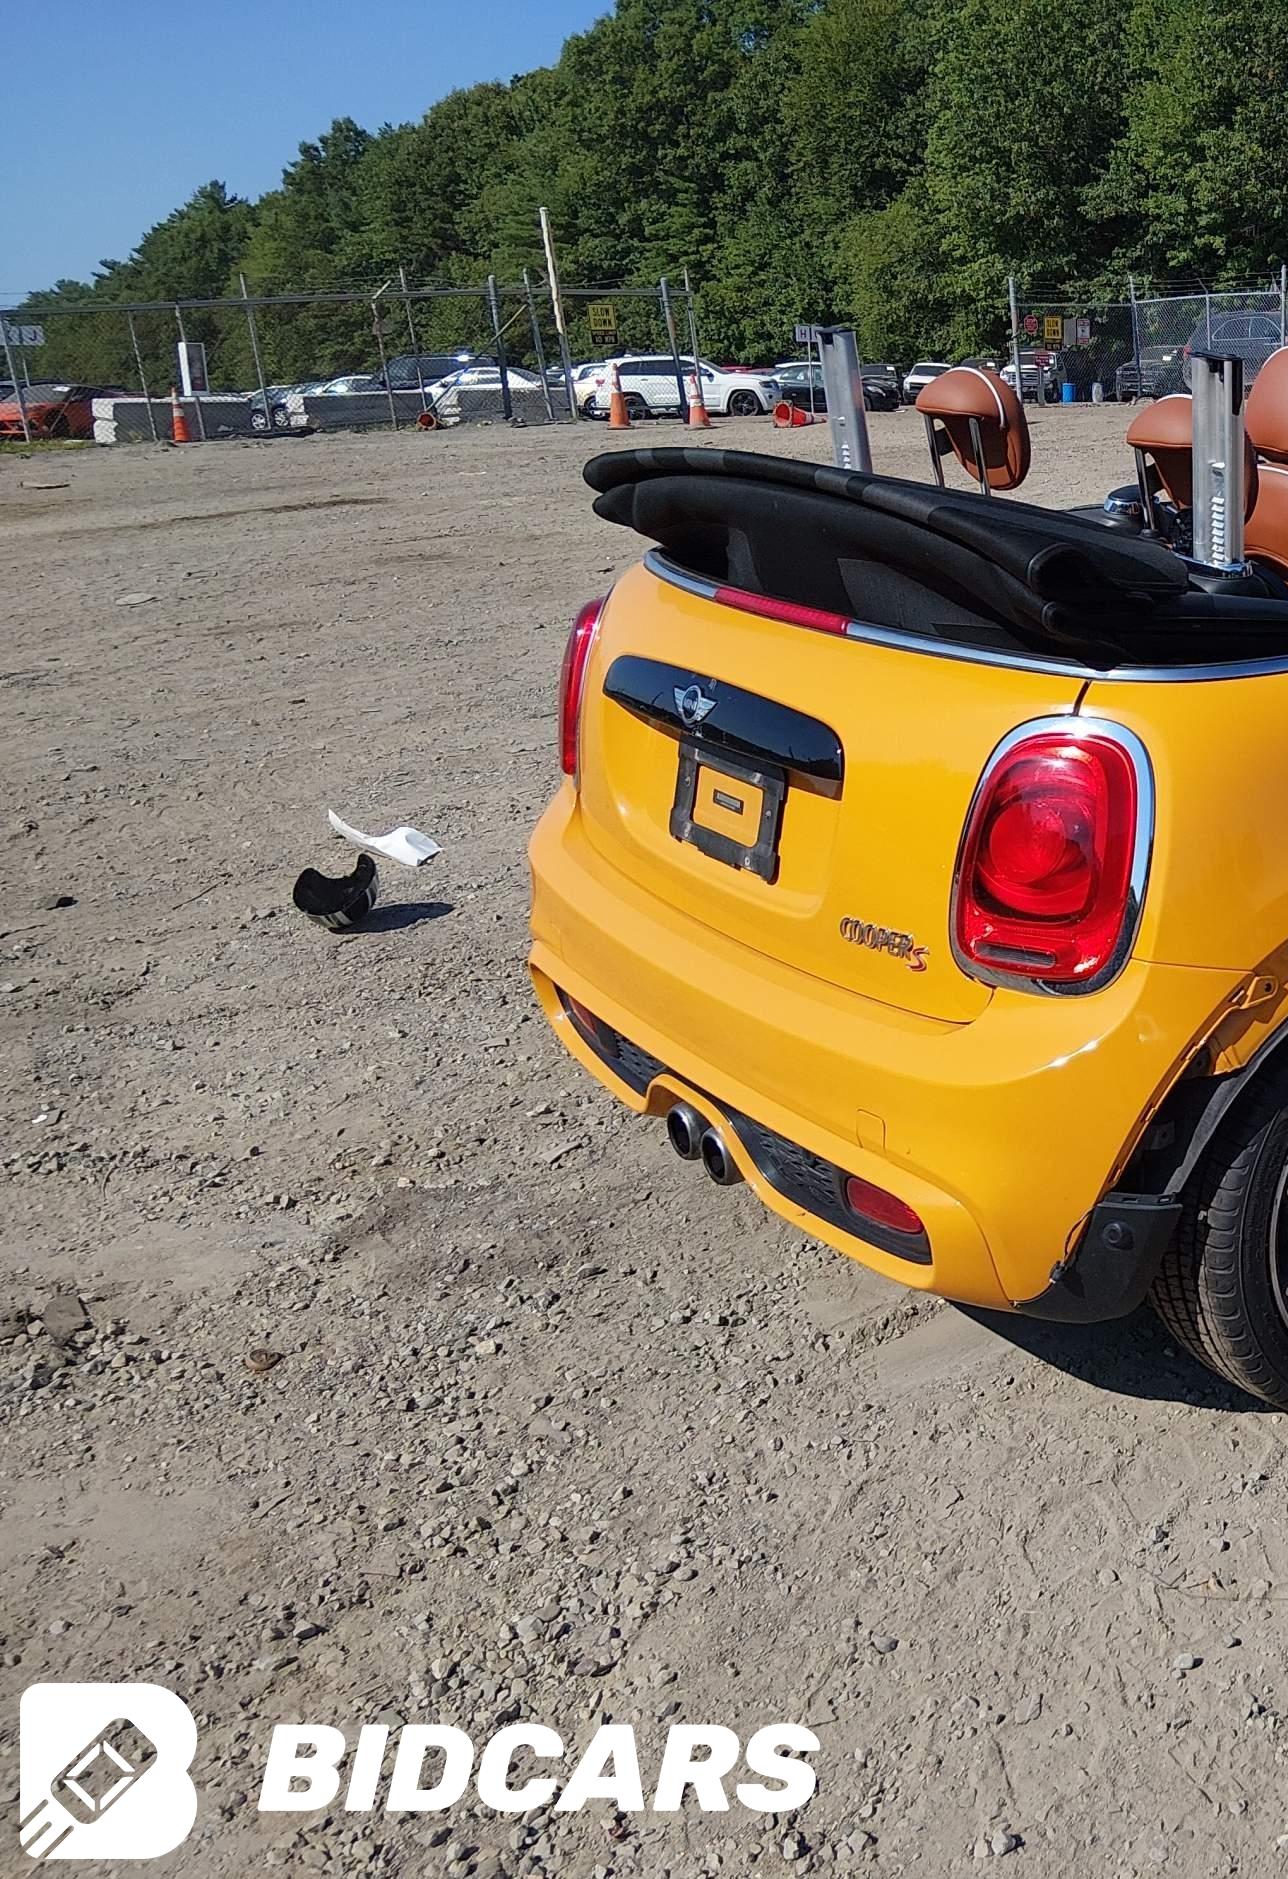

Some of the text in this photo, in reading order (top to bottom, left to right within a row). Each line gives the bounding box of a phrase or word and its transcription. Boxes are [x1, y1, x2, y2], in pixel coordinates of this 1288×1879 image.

[592, 307, 610, 317] SLOW
[593, 318, 612, 328] DOWN
[800, 329, 807, 339] H
[840, 916, 930, 972] COOPER S
